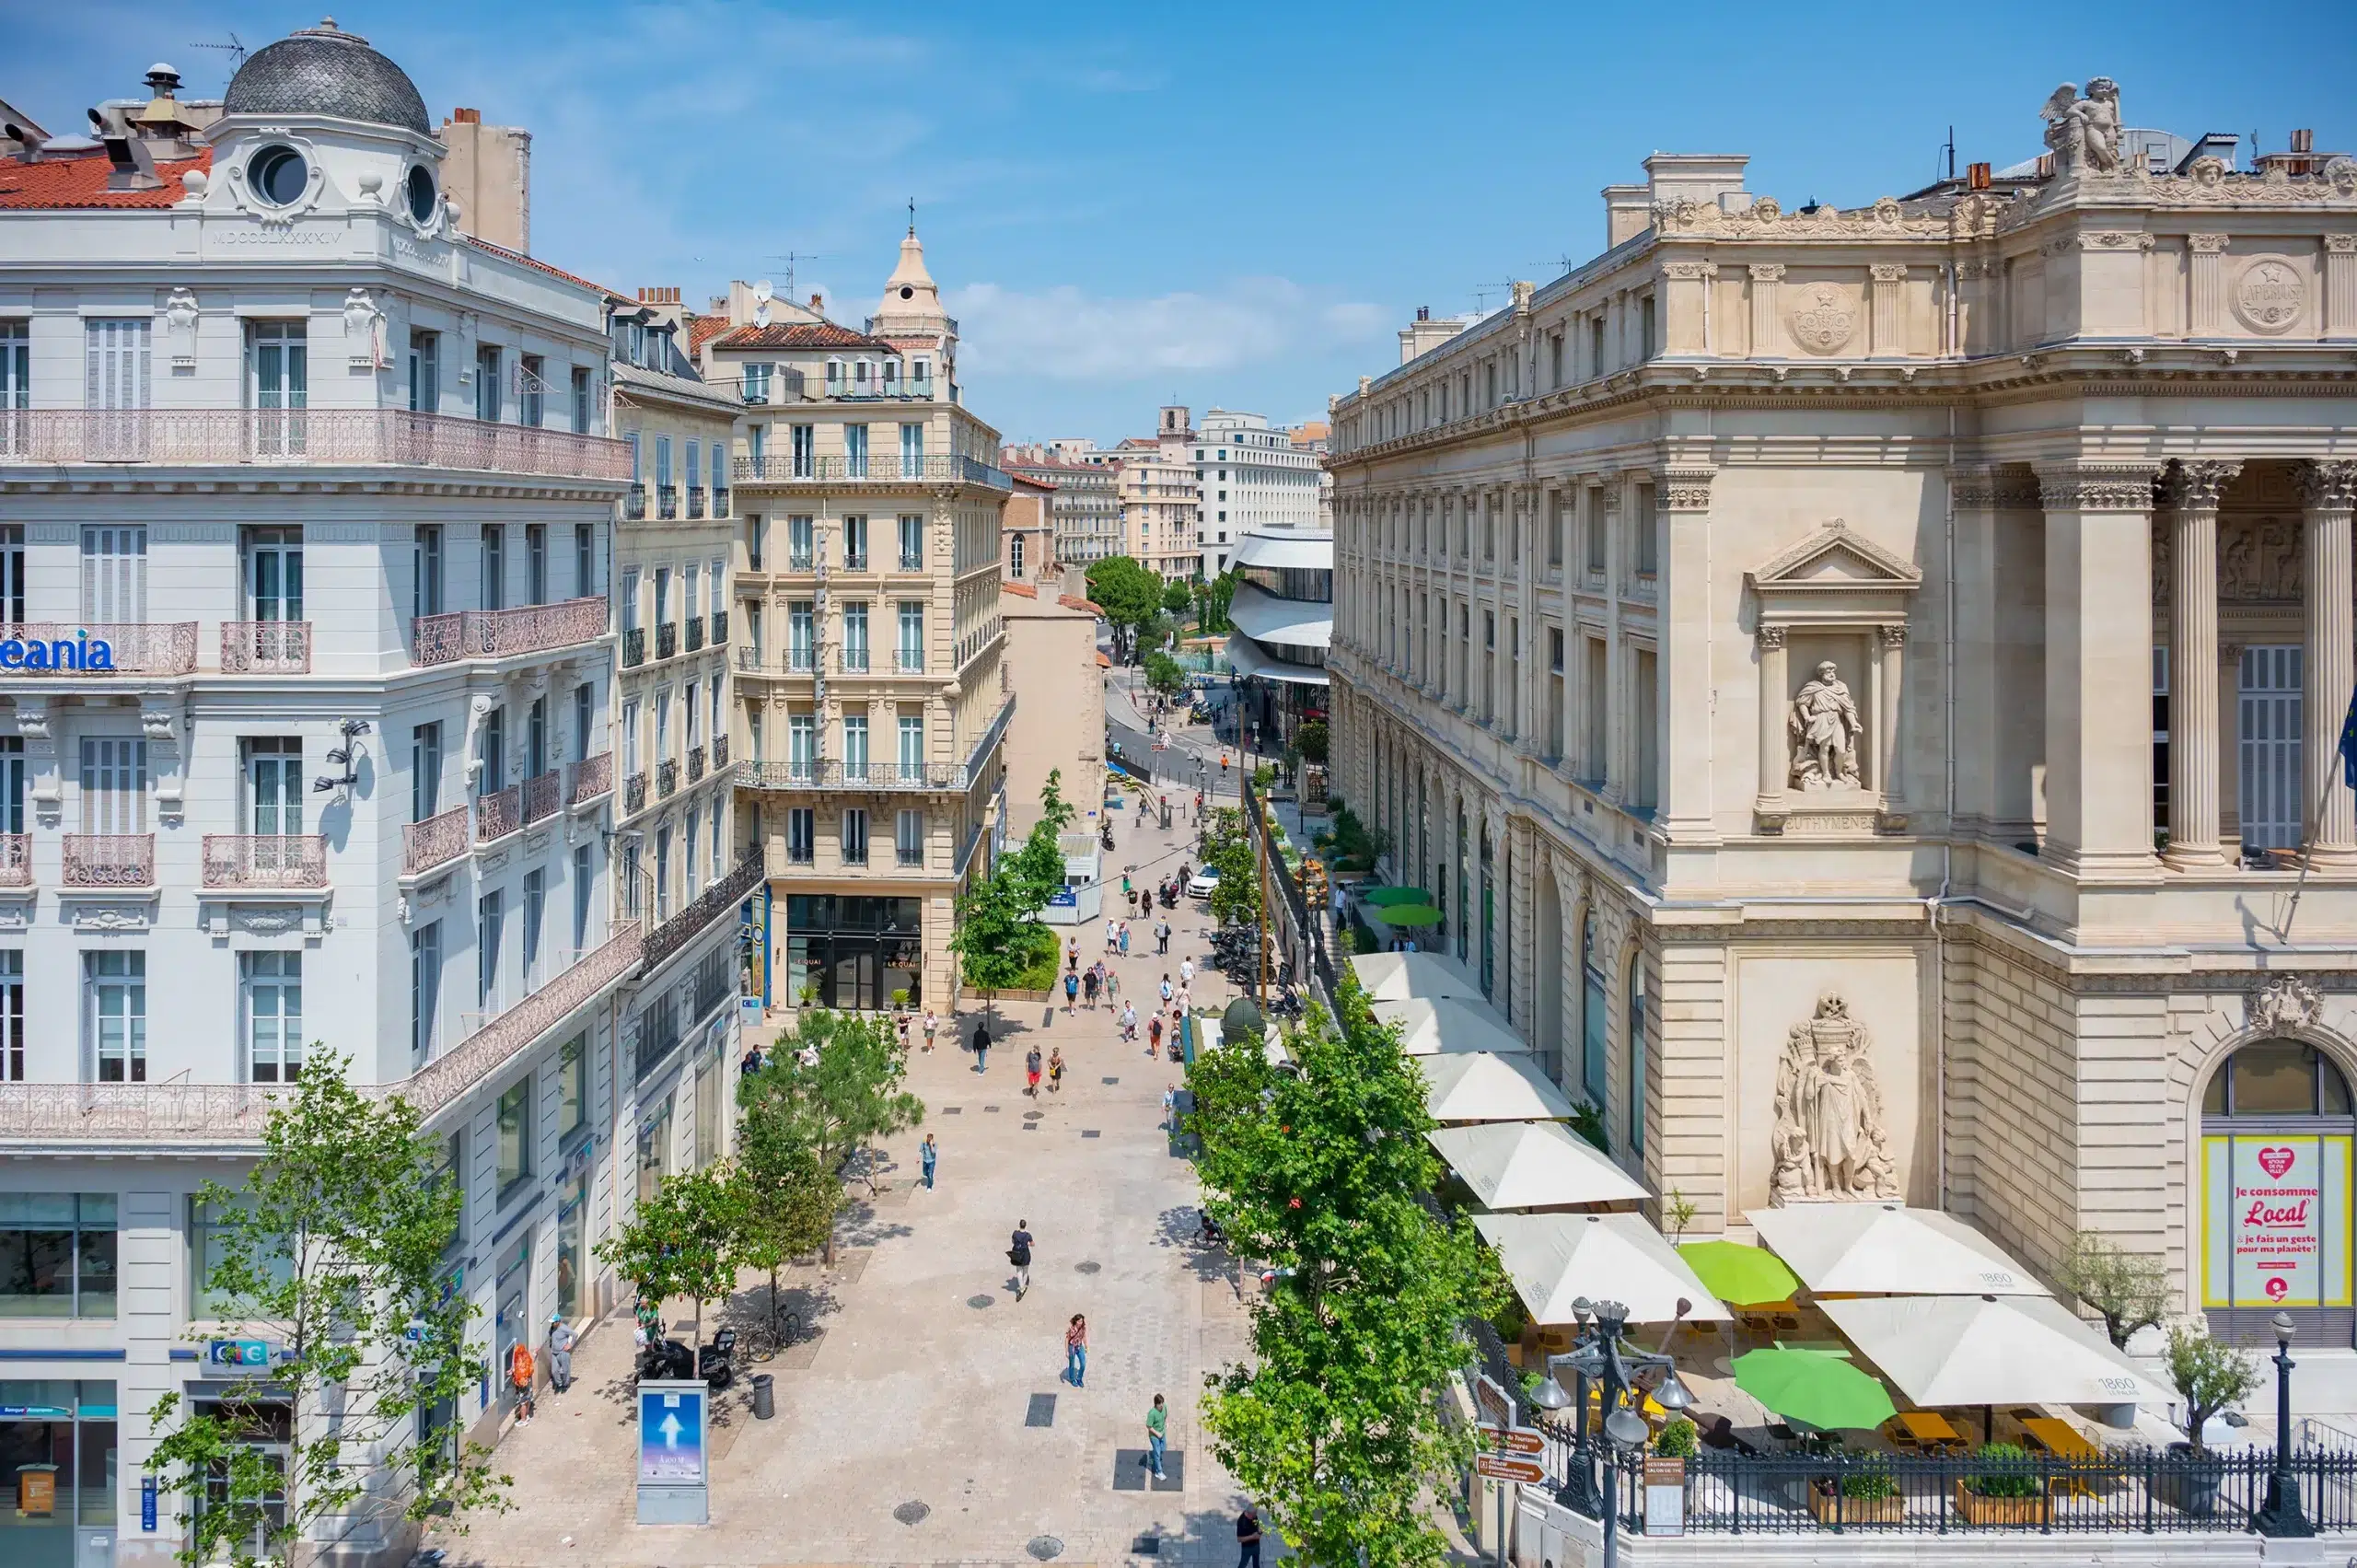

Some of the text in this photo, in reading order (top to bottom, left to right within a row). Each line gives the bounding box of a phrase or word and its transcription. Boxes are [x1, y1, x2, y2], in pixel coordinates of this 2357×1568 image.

[0, 628, 114, 669] eania
[1785, 816, 1875, 830] EUTHYMENES
[2235, 1187, 2318, 1199] Je consomme
[2243, 1199, 2310, 1226] Local
[2245, 1235, 2255, 1245] je
[2257, 1235, 2274, 1243] fais
[2291, 1236, 2316, 1246] geste
[2277, 1244, 2312, 1255] planète
[1979, 1272, 2012, 1283] 1860
[2098, 1377, 2136, 1389] 1860
[1515, 1434, 1538, 1445] Tourisme
